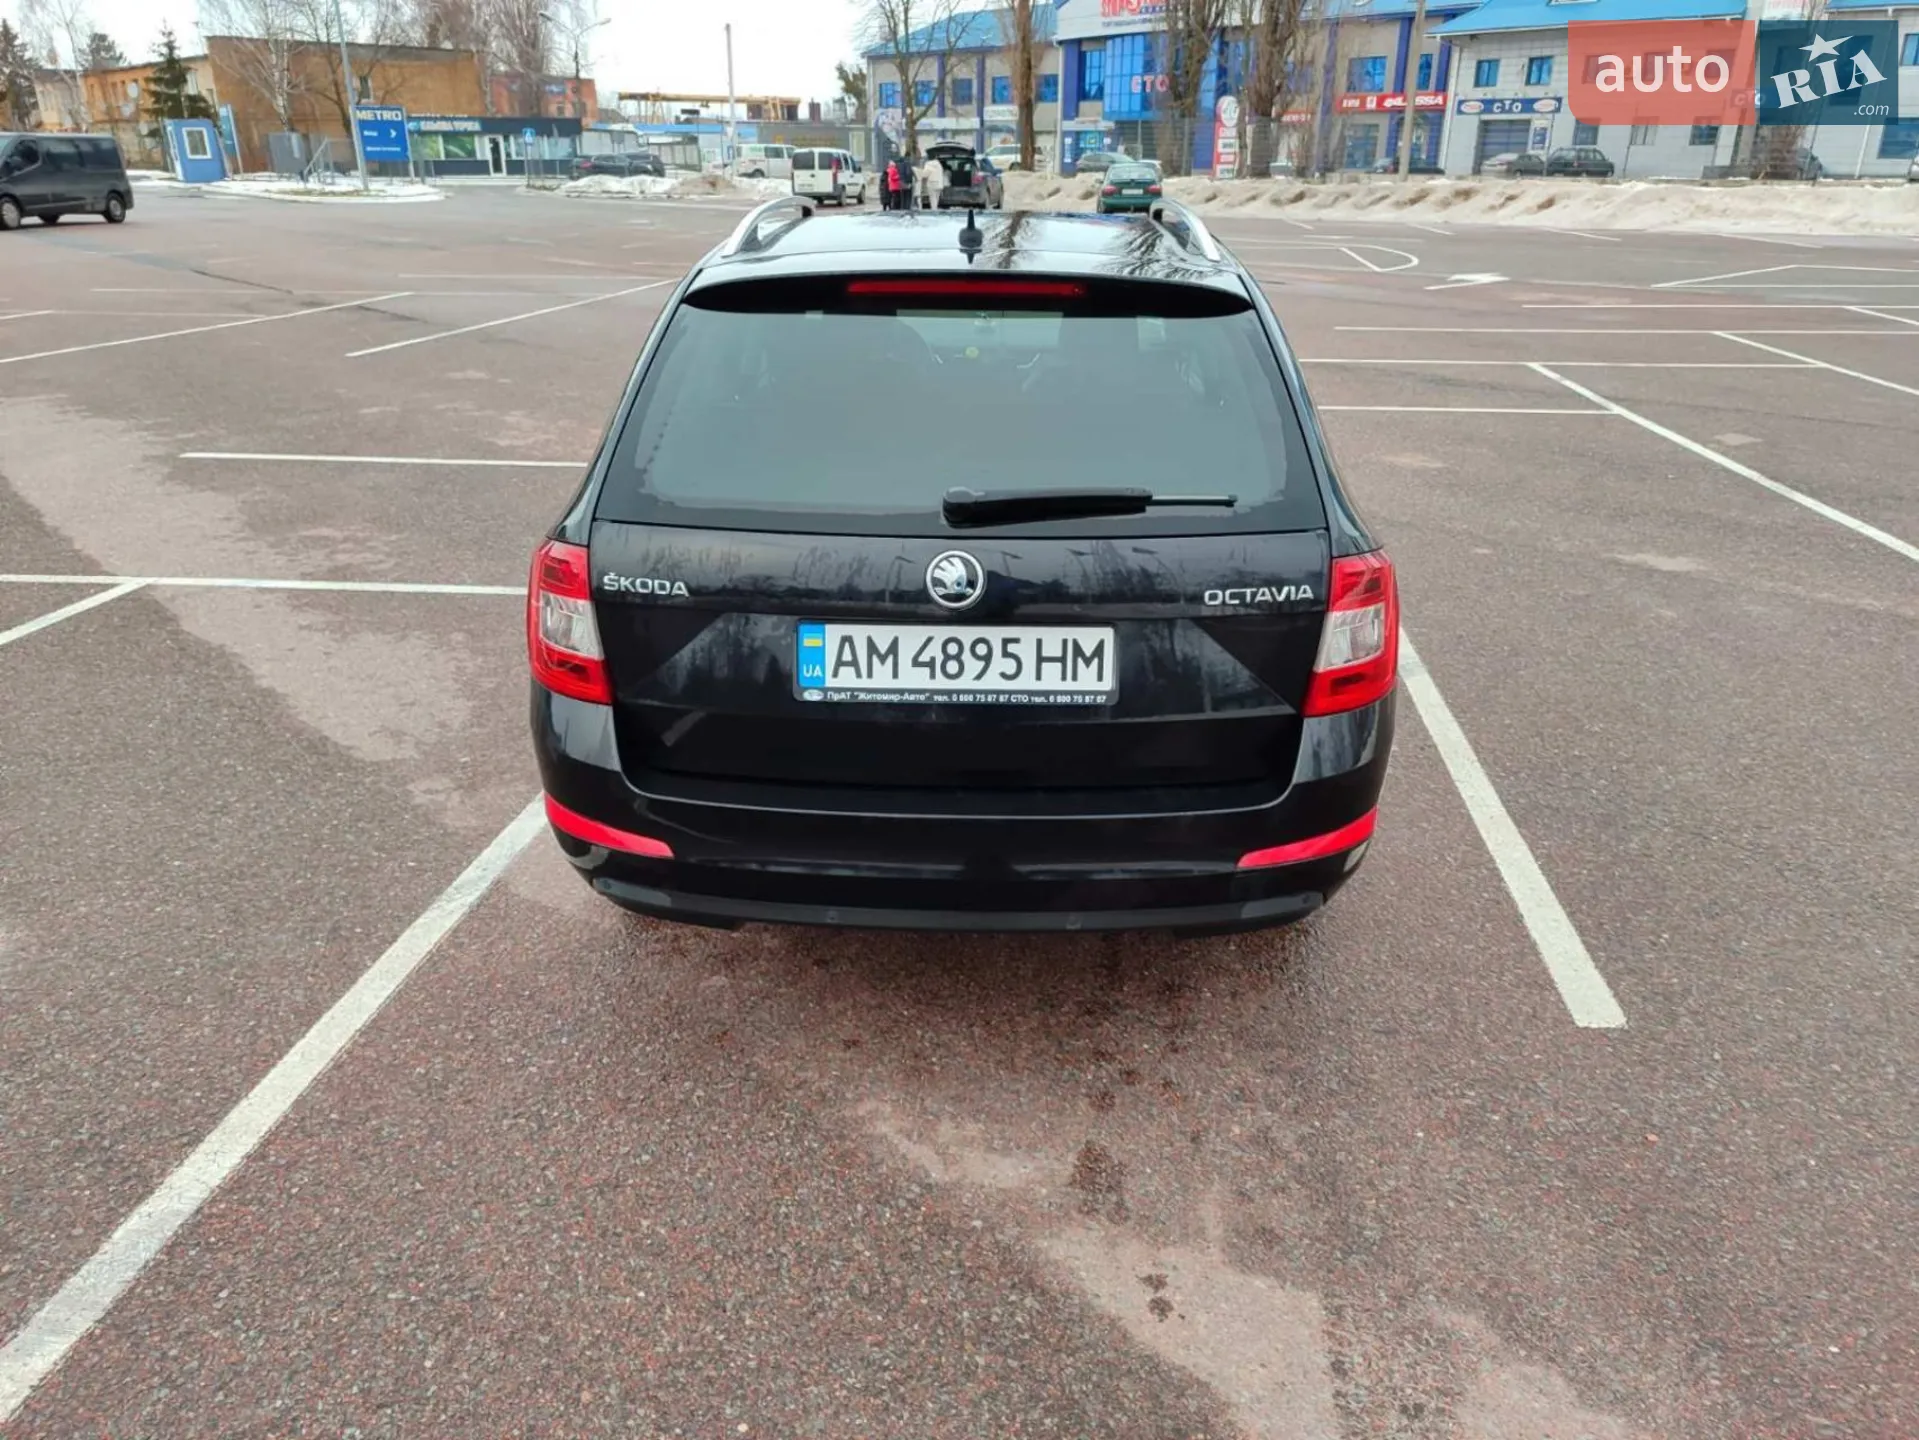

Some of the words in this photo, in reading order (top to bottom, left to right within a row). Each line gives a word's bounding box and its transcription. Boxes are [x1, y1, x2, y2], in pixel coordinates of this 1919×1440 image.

[355, 109, 402, 121] METRO
[1493, 100, 1522, 113] СТО
[603, 572, 690, 597] ŠKODA
[1204, 584, 1314, 606] OCTAVIA
[911, 636, 1023, 681] 4895
[803, 665, 822, 678] UA
